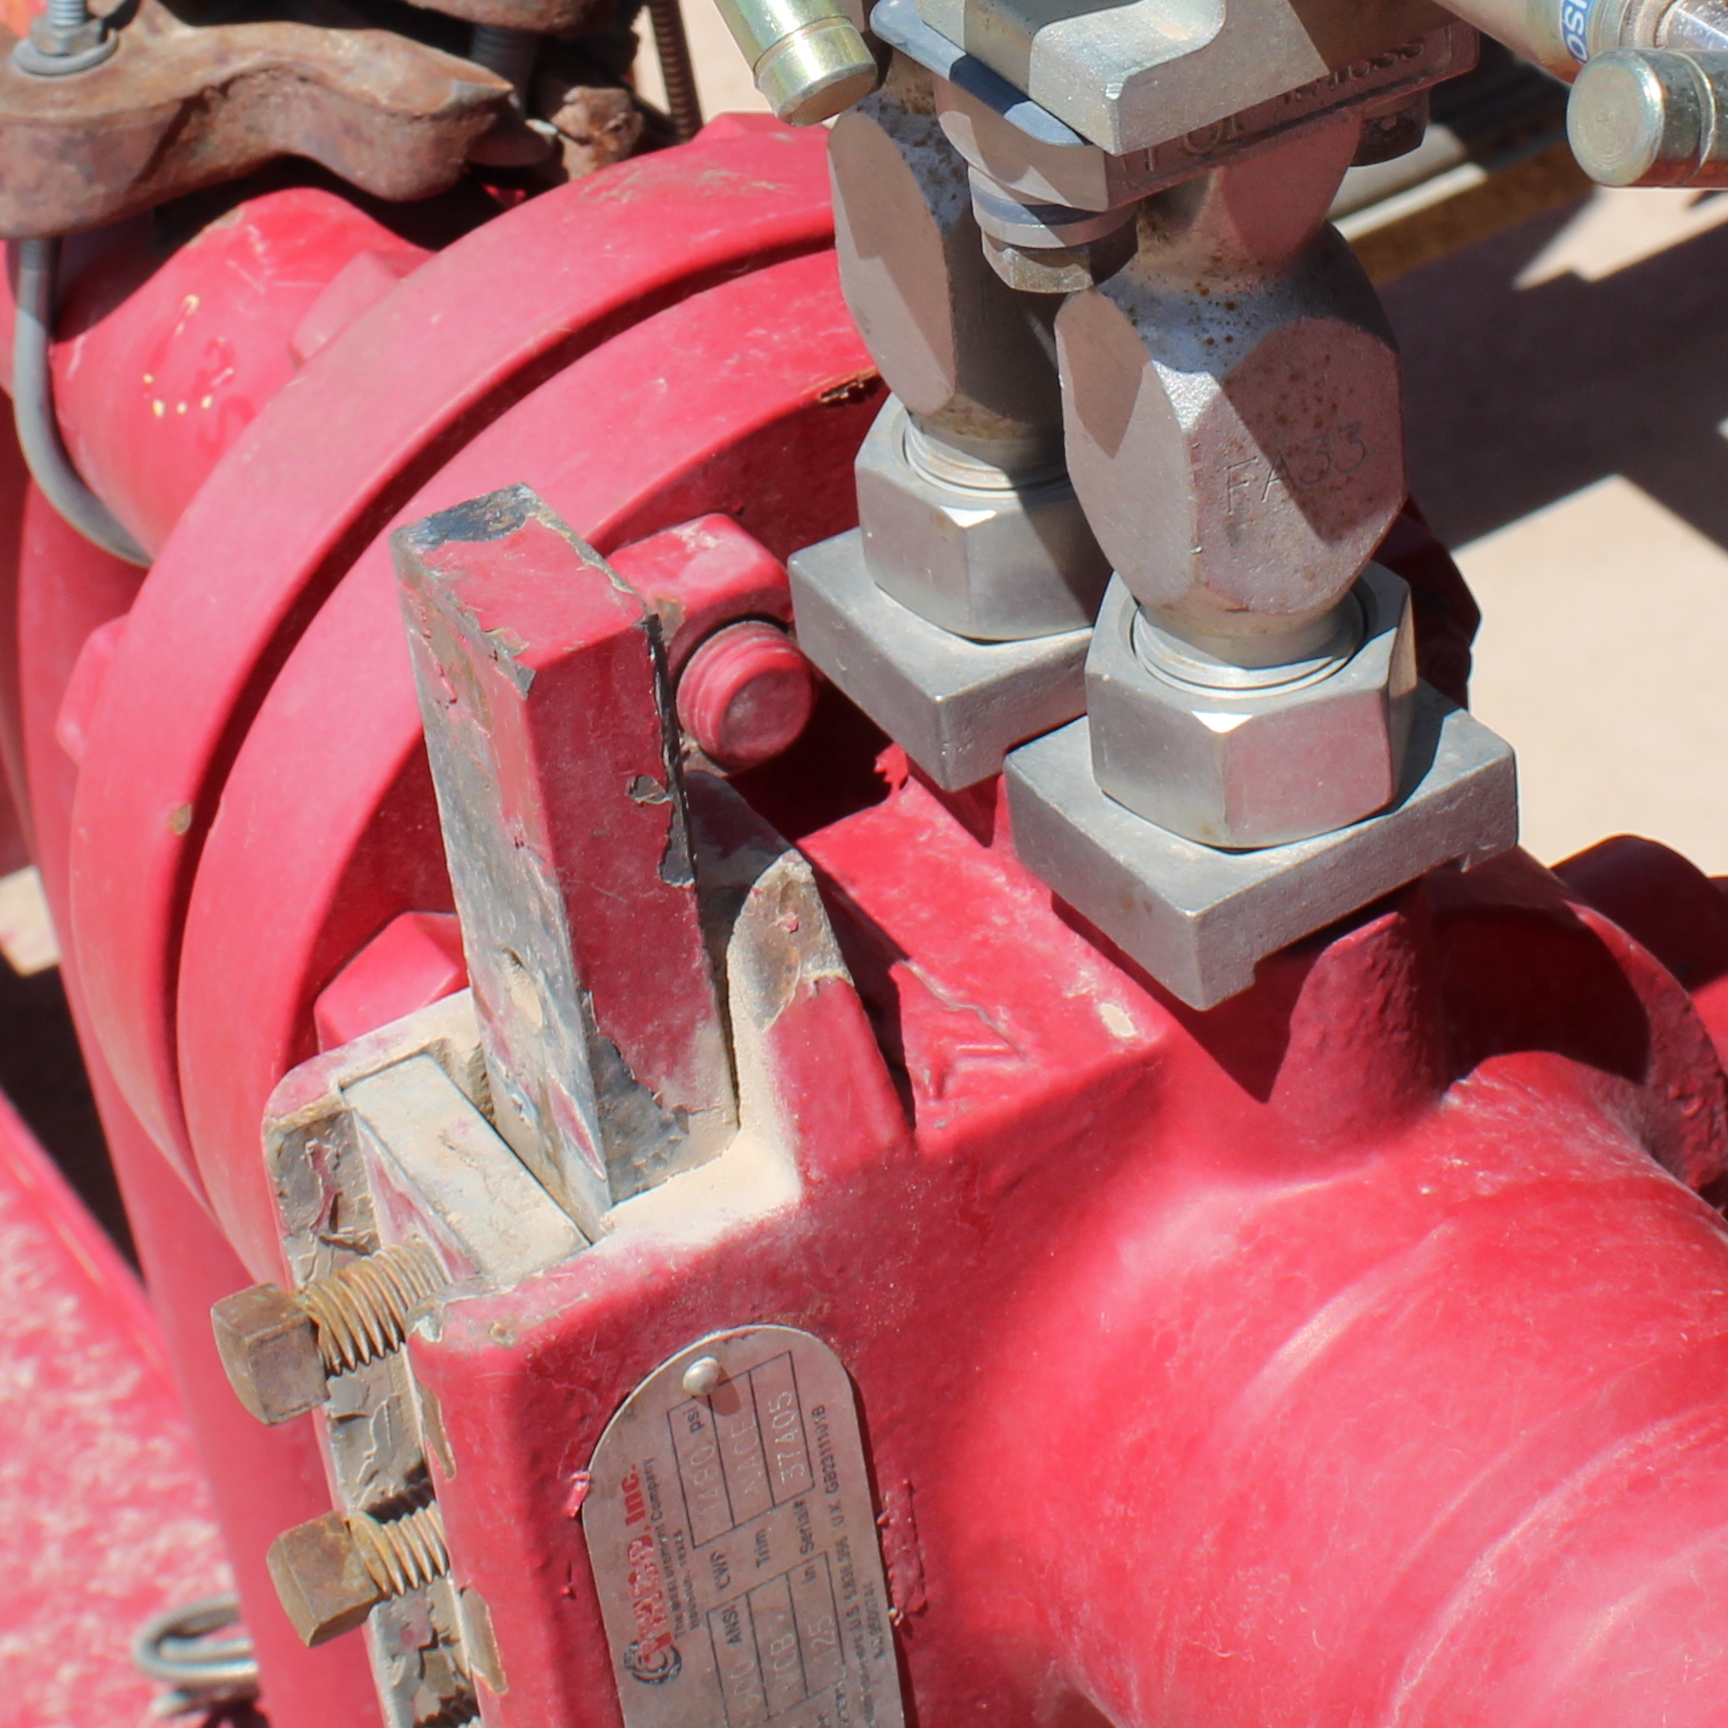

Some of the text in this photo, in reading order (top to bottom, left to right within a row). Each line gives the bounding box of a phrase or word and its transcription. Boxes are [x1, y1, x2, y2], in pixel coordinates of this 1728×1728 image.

[683, 1407, 705, 1435] psi
[768, 1391, 805, 1485] 37405
[622, 1463, 646, 1526] Inc.
[643, 1457, 663, 1522] Company
[754, 1528, 771, 1569] Trim
[710, 1549, 731, 1590] CWP
[722, 1605, 742, 1645] ANSI
